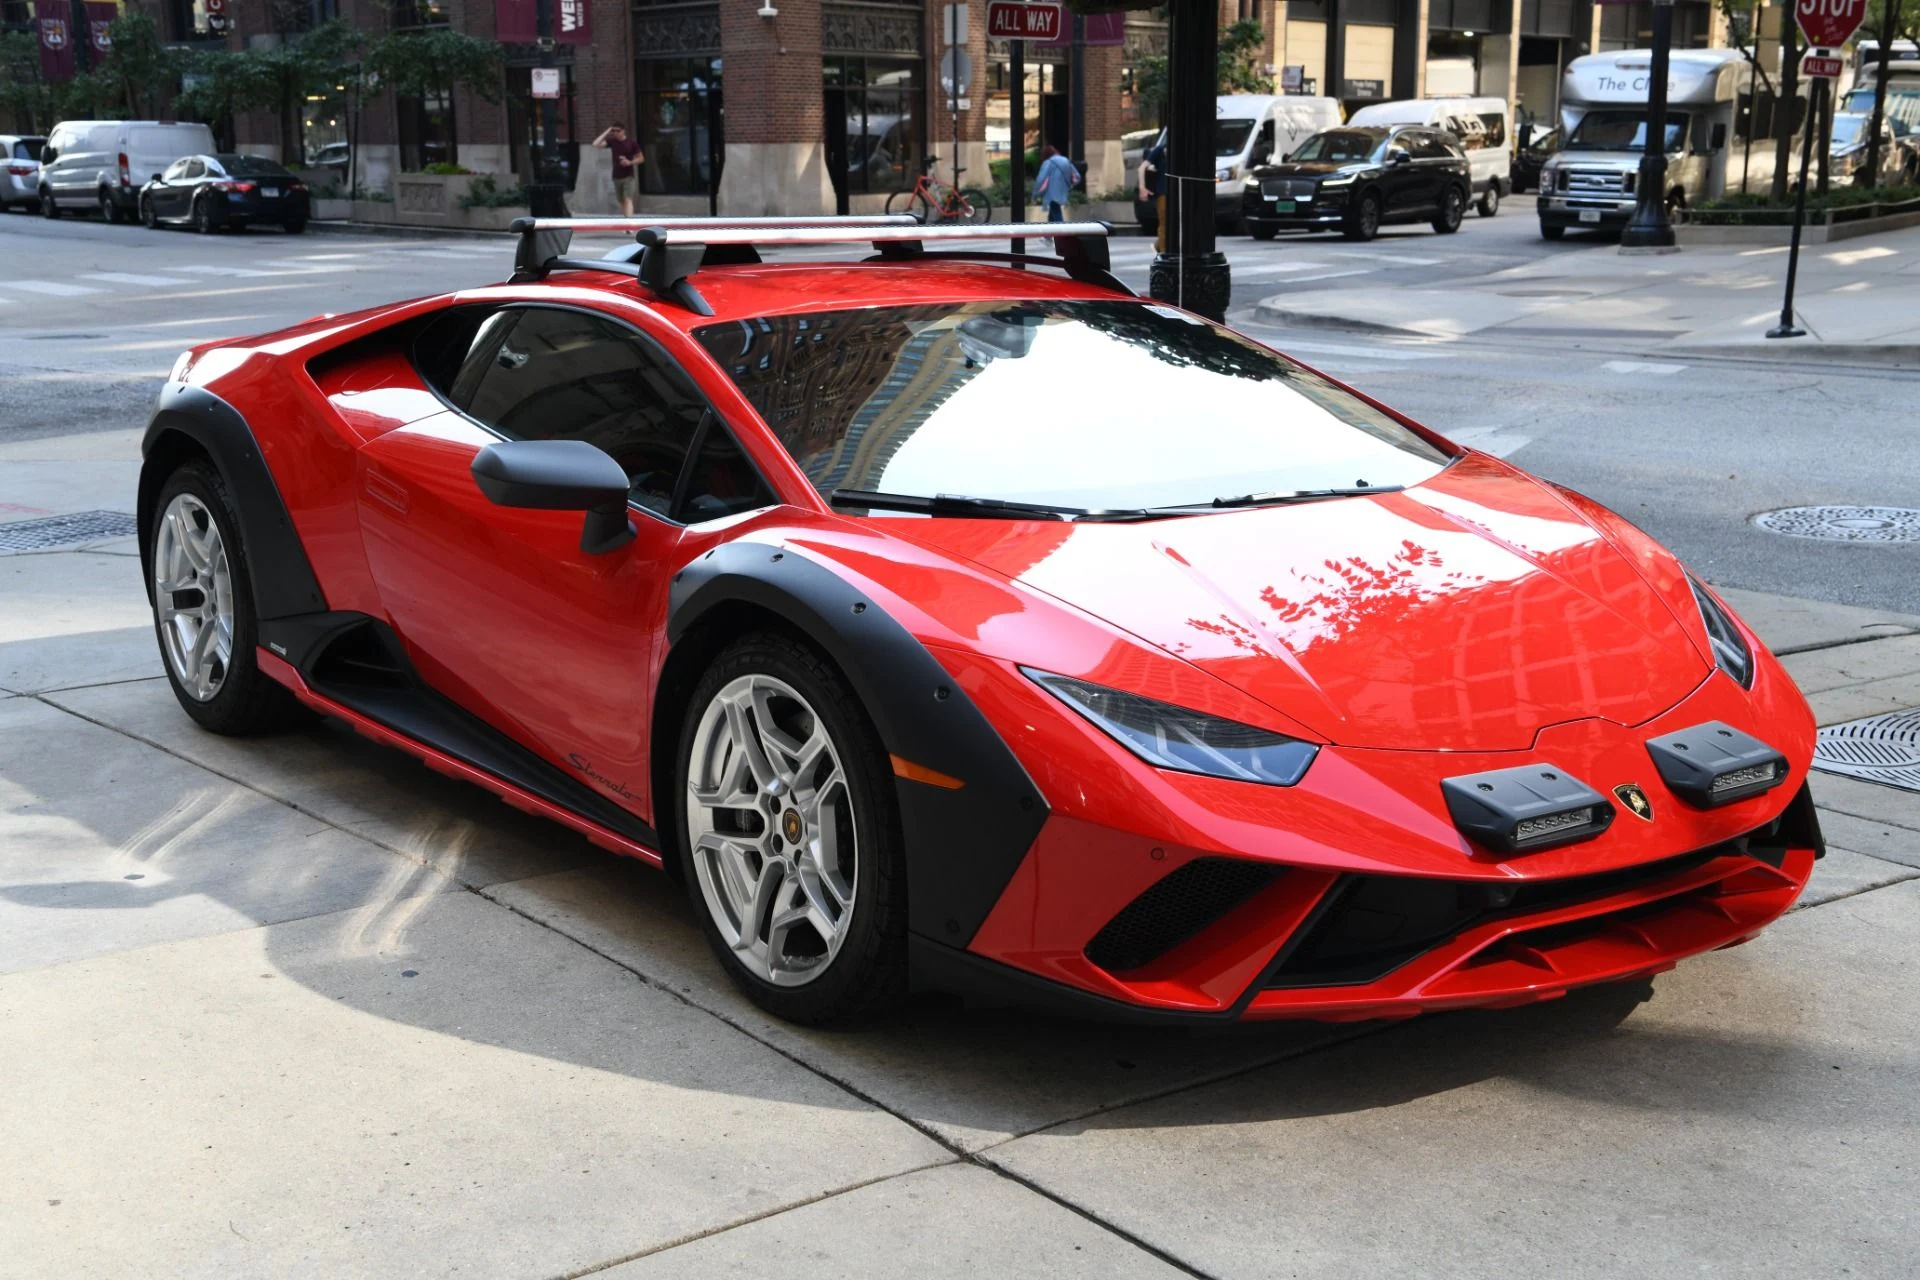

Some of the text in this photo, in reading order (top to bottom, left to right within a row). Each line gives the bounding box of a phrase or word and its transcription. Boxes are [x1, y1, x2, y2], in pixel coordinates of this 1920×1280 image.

[561, 0, 576, 32] WE
[995, 9, 1053, 32] ALL WAY
[1806, 60, 1840, 74] ALL WAY
[1598, 77, 1627, 91] The
[568, 752, 643, 800] Sterrato
